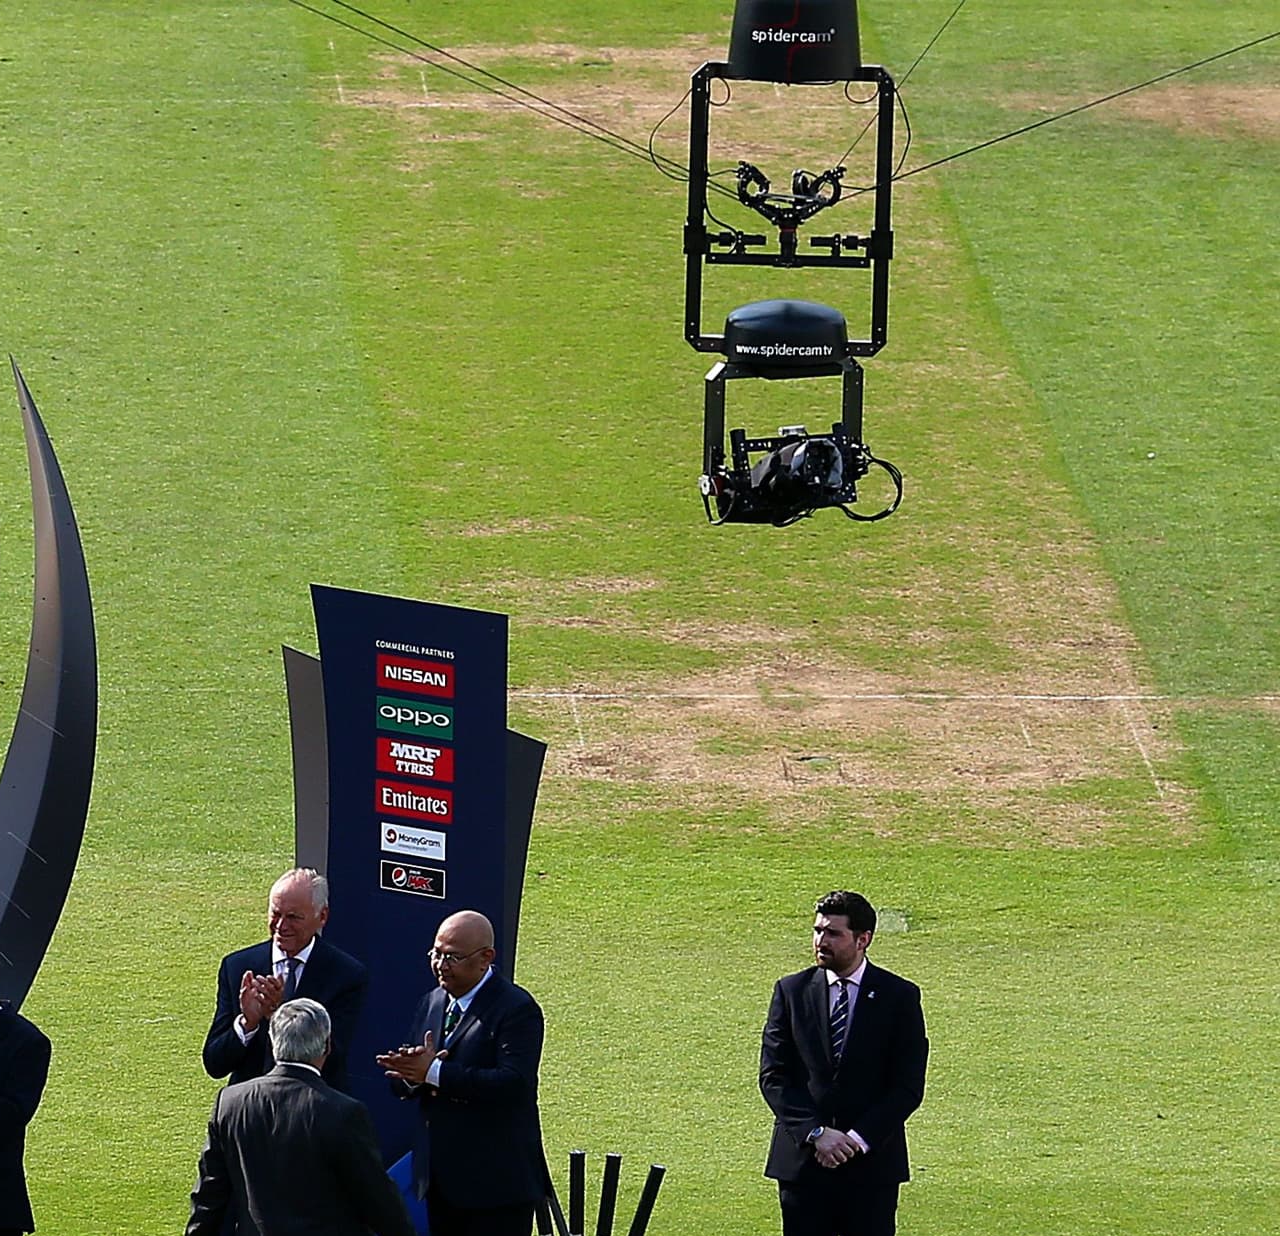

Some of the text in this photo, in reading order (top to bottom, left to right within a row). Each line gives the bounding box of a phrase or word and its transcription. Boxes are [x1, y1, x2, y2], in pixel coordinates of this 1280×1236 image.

[375, 639, 455, 660] COMMERCIAL PARTNERS
[385, 665, 447, 687] NISSAN
[379, 705, 450, 726] oppo
[389, 741, 441, 763] MRF
[396, 759, 434, 777] TYRES
[382, 787, 448, 816] Emirates
